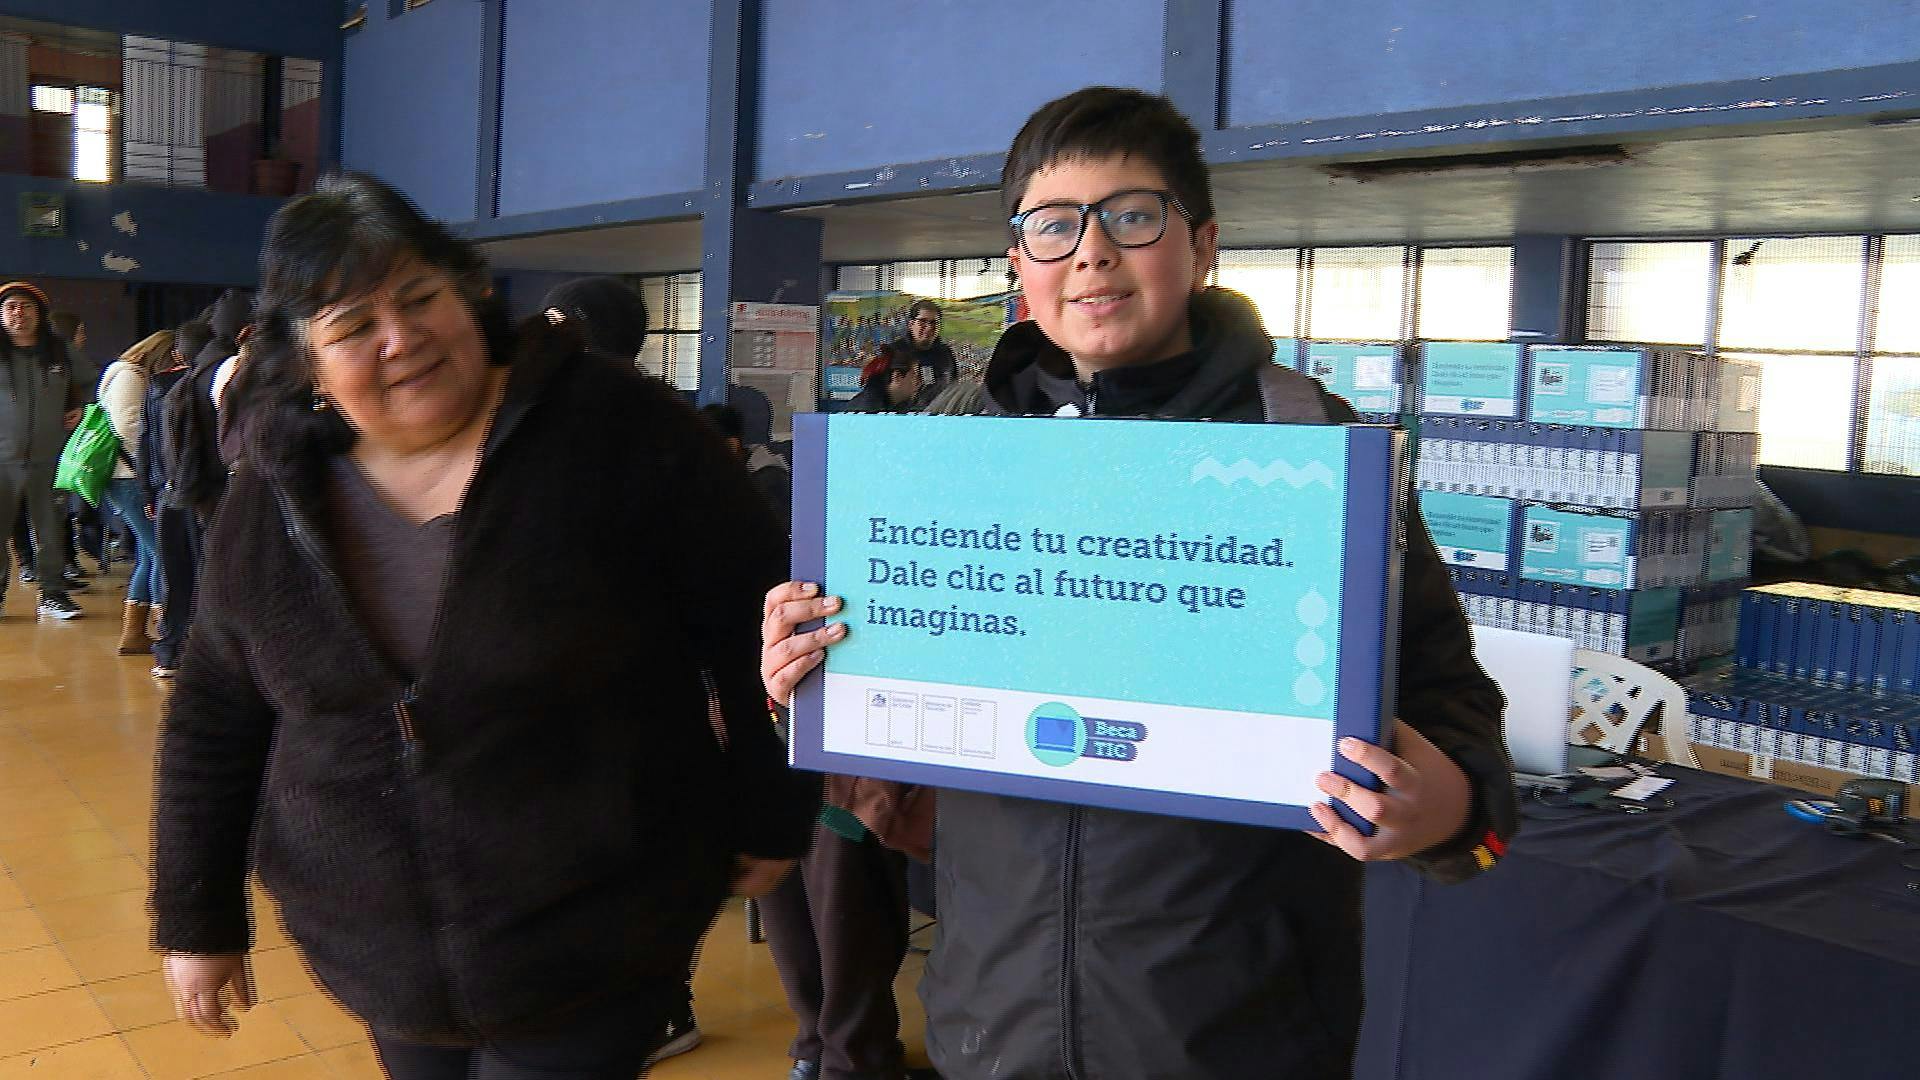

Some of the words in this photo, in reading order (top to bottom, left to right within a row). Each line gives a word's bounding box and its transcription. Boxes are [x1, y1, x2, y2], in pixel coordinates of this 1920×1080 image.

[868, 517, 1022, 552] Enciende
[1030, 527, 1068, 555] tu
[1076, 532, 1295, 568] creatividad.
[867, 557, 938, 589] Dale
[946, 563, 1006, 593] clic
[1014, 568, 1045, 596] al
[1053, 569, 1168, 604] futuro
[1176, 584, 1247, 614] que
[866, 598, 1028, 637] imaginas.
[1094, 720, 1138, 740] Beca
[1094, 741, 1128, 758] TIC
